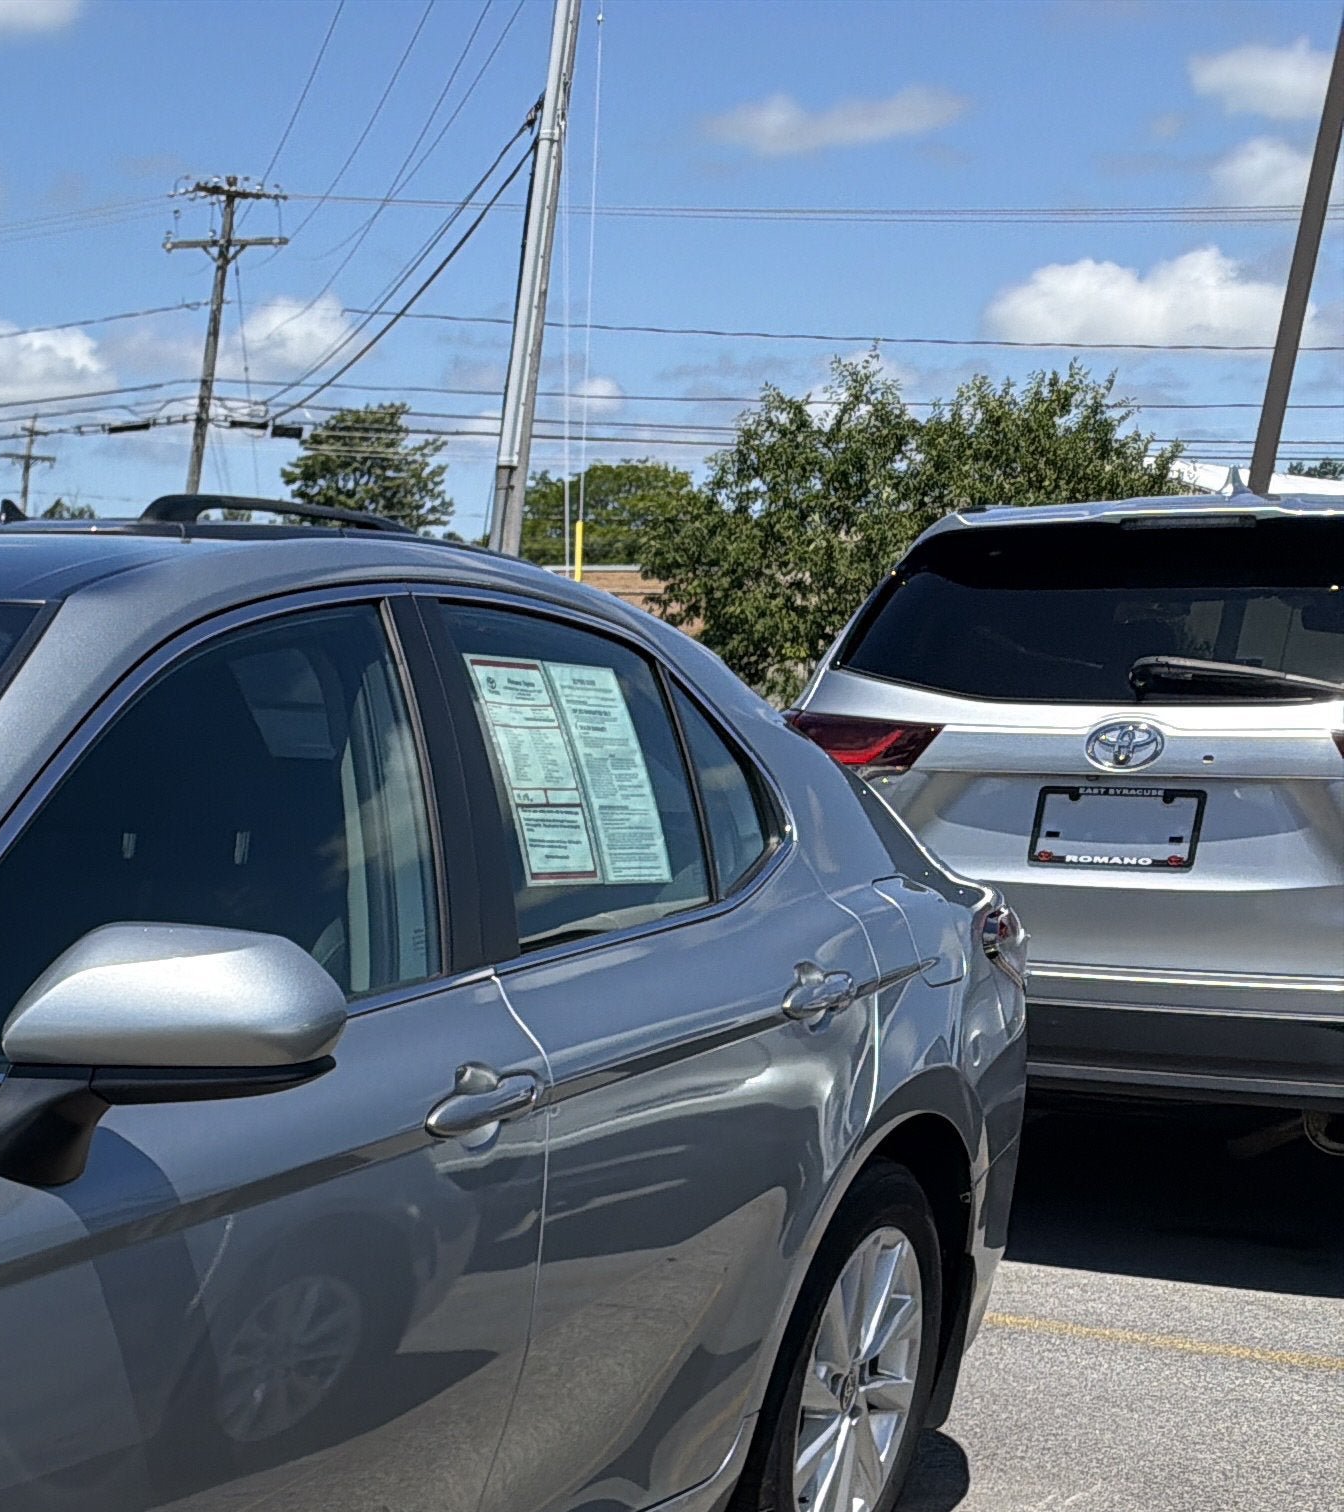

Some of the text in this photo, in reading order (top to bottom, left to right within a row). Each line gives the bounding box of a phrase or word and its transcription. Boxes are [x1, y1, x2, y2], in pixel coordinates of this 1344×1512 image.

[1078, 787, 1165, 796] EAST SYRACUSE
[1064, 854, 1153, 866] ROMANO
